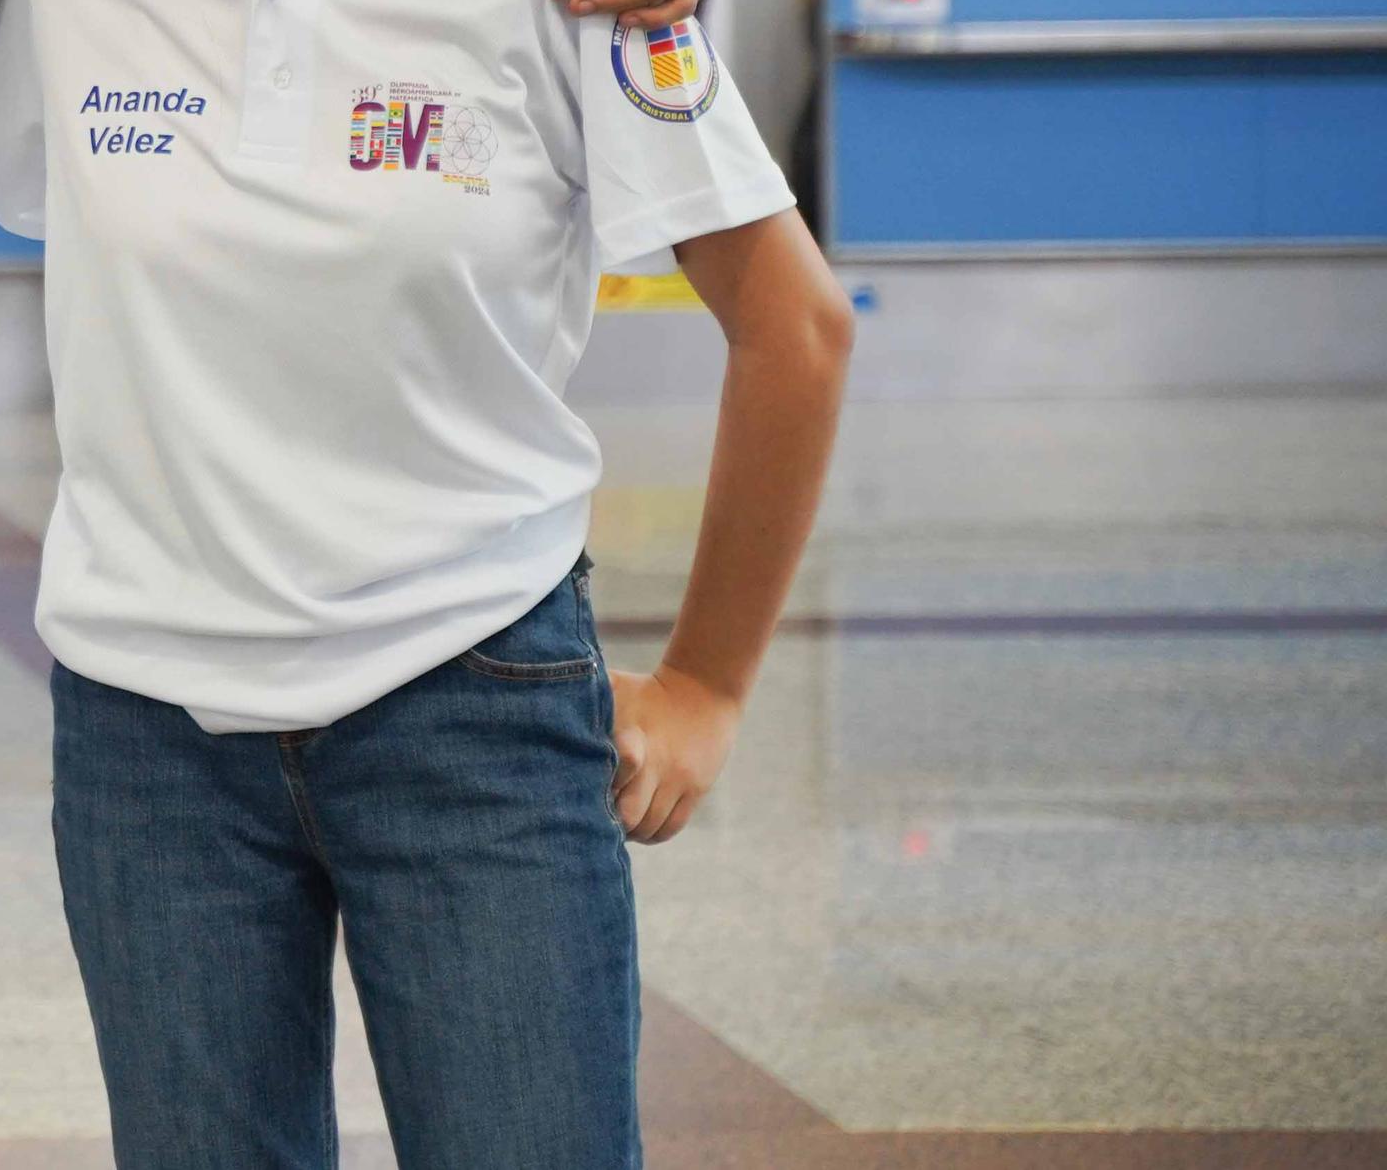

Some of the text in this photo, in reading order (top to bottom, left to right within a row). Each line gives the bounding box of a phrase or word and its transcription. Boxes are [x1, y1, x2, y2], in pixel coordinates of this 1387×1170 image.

[80, 86, 207, 115] Ananda
[641, 102, 690, 120] CRISTOBAL
[90, 126, 174, 155] Vélez
